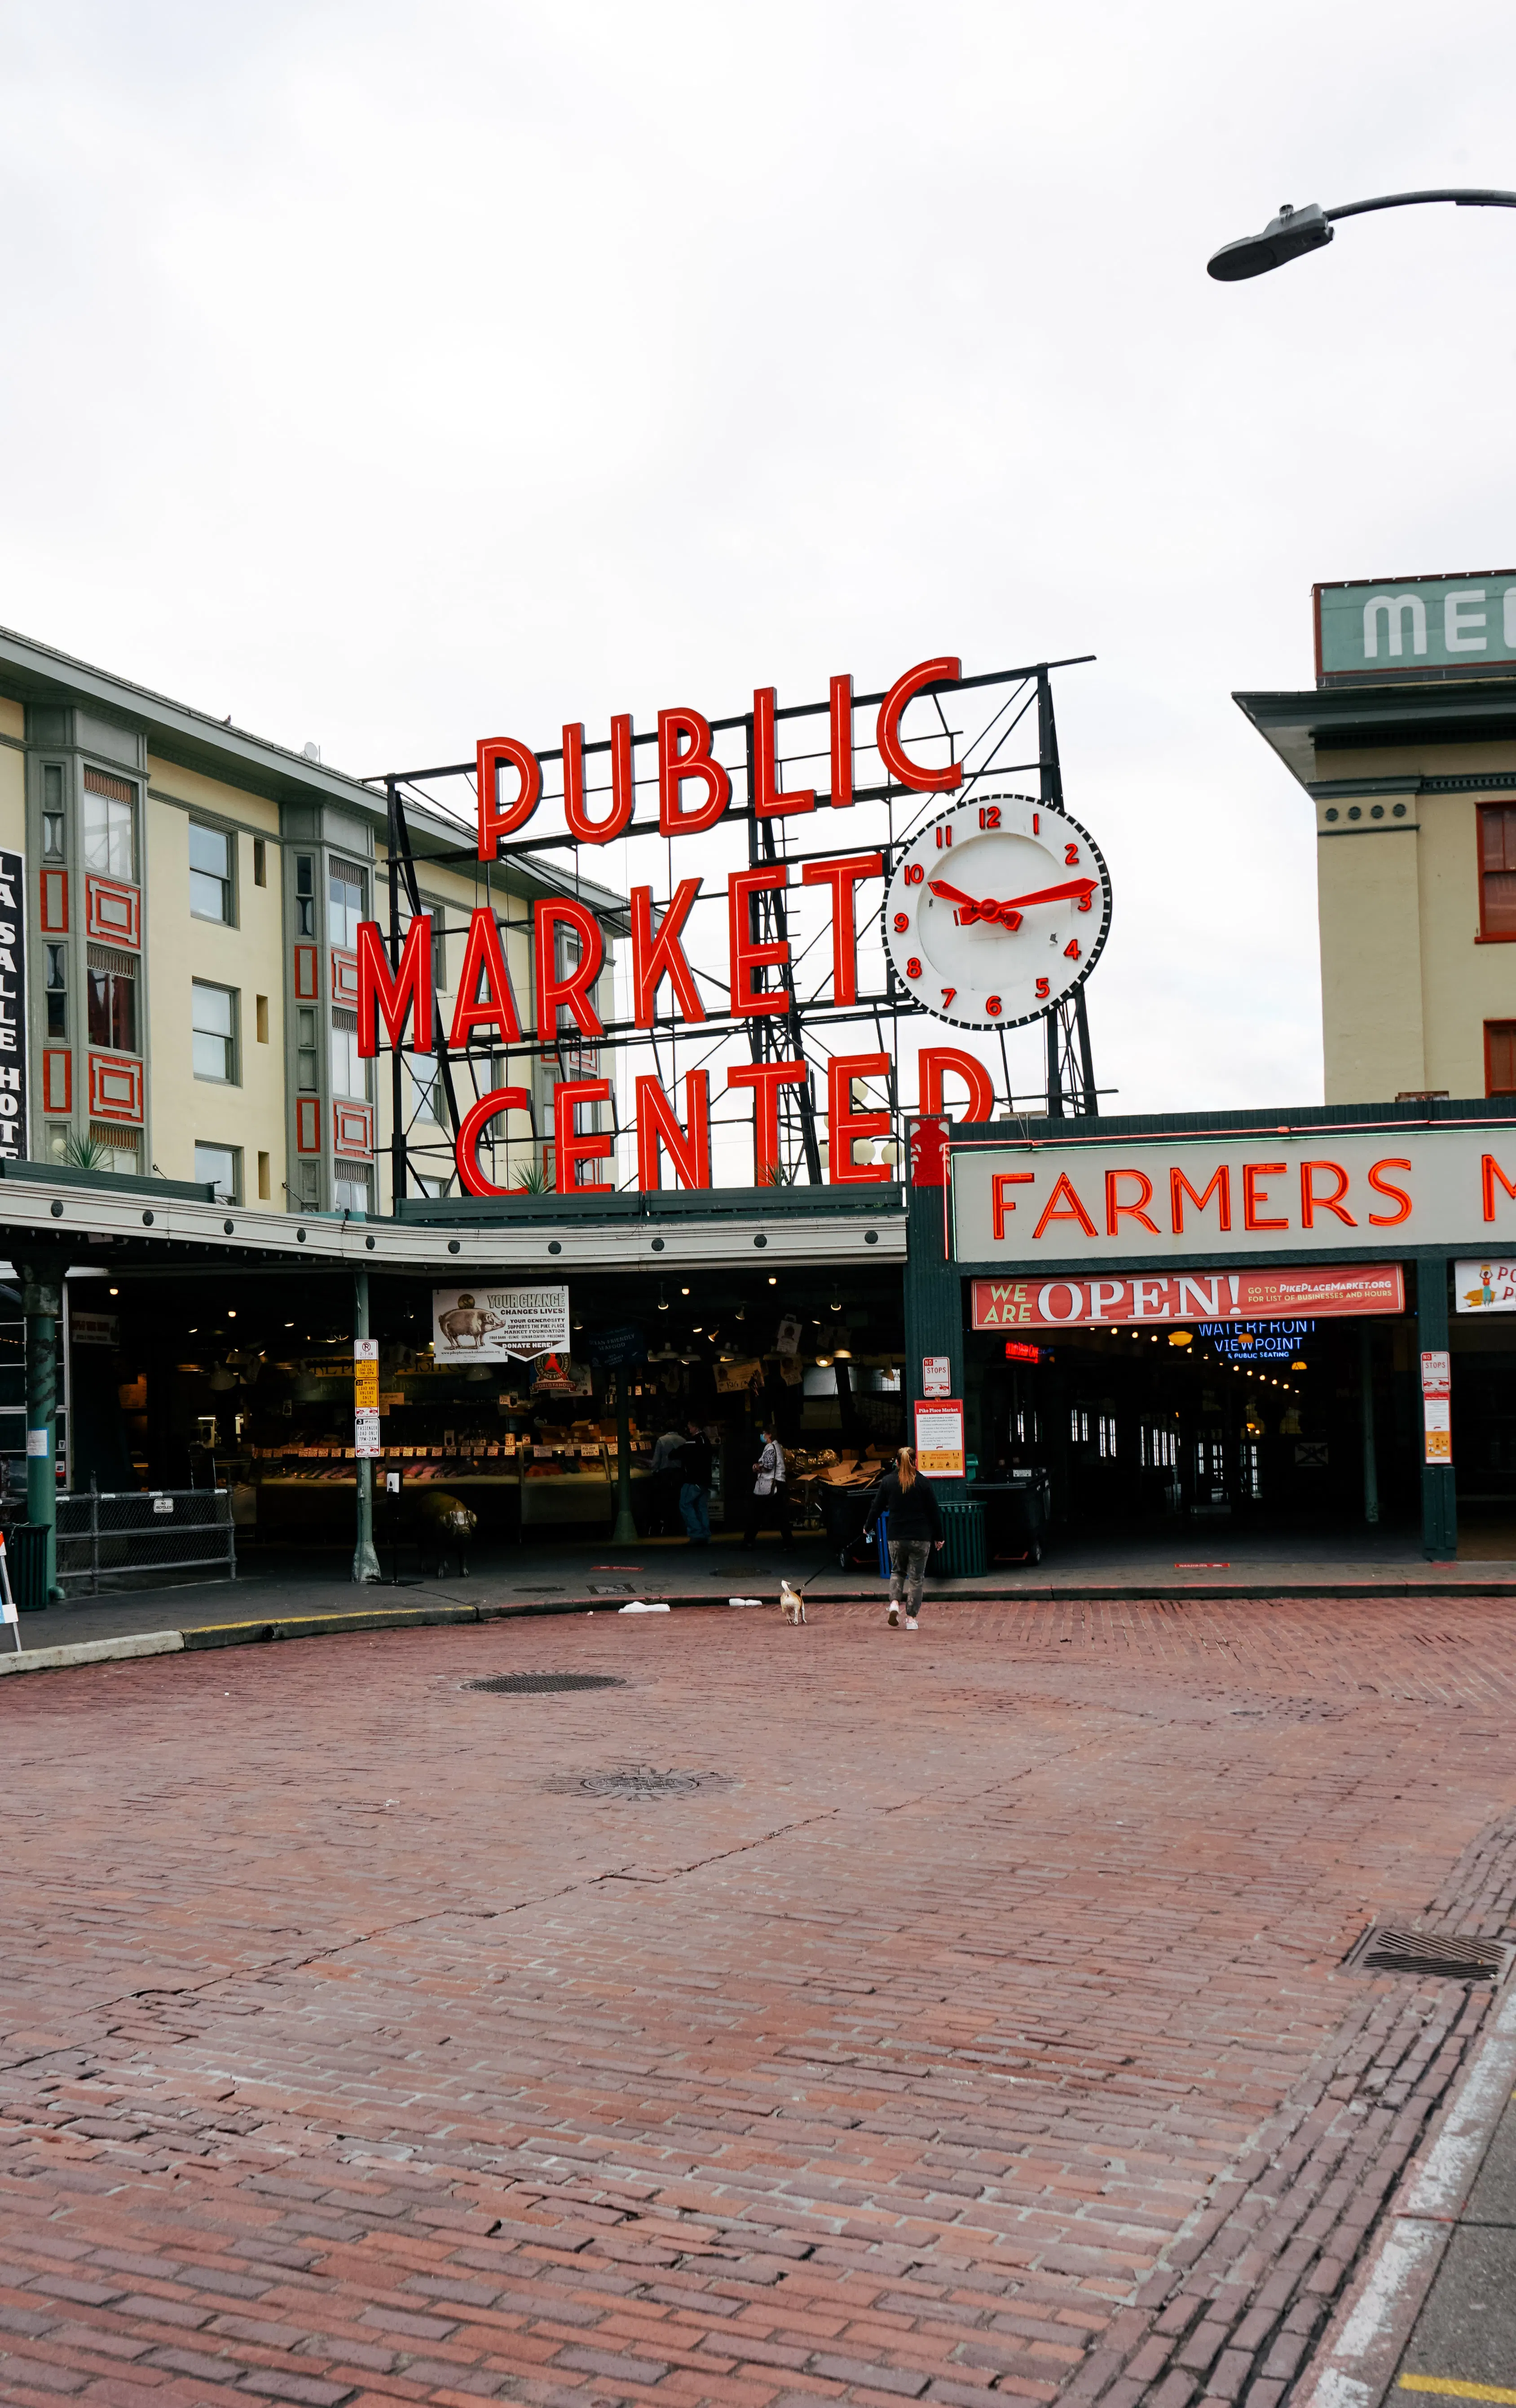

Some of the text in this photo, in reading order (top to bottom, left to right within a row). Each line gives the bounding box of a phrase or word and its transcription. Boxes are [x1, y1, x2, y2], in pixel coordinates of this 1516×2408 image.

[477, 656, 964, 861] PUBLIC
[979, 807, 1001, 830] 12
[1033, 813, 1040, 835] 1
[936, 825, 952, 848] 11
[1064, 844, 1080, 866] 2
[904, 864, 924, 885] 10
[1078, 892, 1092, 911] 3
[894, 913, 909, 933] 9
[357, 853, 883, 1058] MARKET
[1063, 939, 1082, 960] 4
[906, 958, 922, 979] 8
[941, 988, 957, 1009] 7
[1035, 978, 1050, 998] 5
[986, 996, 1002, 1016] 6
[456, 1048, 994, 1196] CENTER
[992, 1158, 1412, 1240] FARMERS
[487, 1293, 565, 1309] YOUR CHANGE
[990, 1284, 1028, 1302] WE
[1037, 1275, 1241, 1322] OPEN!
[1298, 1292, 1344, 1301] BUSINESSES
[1502, 1286, 1516, 1302] P
[984, 1304, 1032, 1323] ARE
[1214, 1337, 1303, 1352] VIEWPOINT
